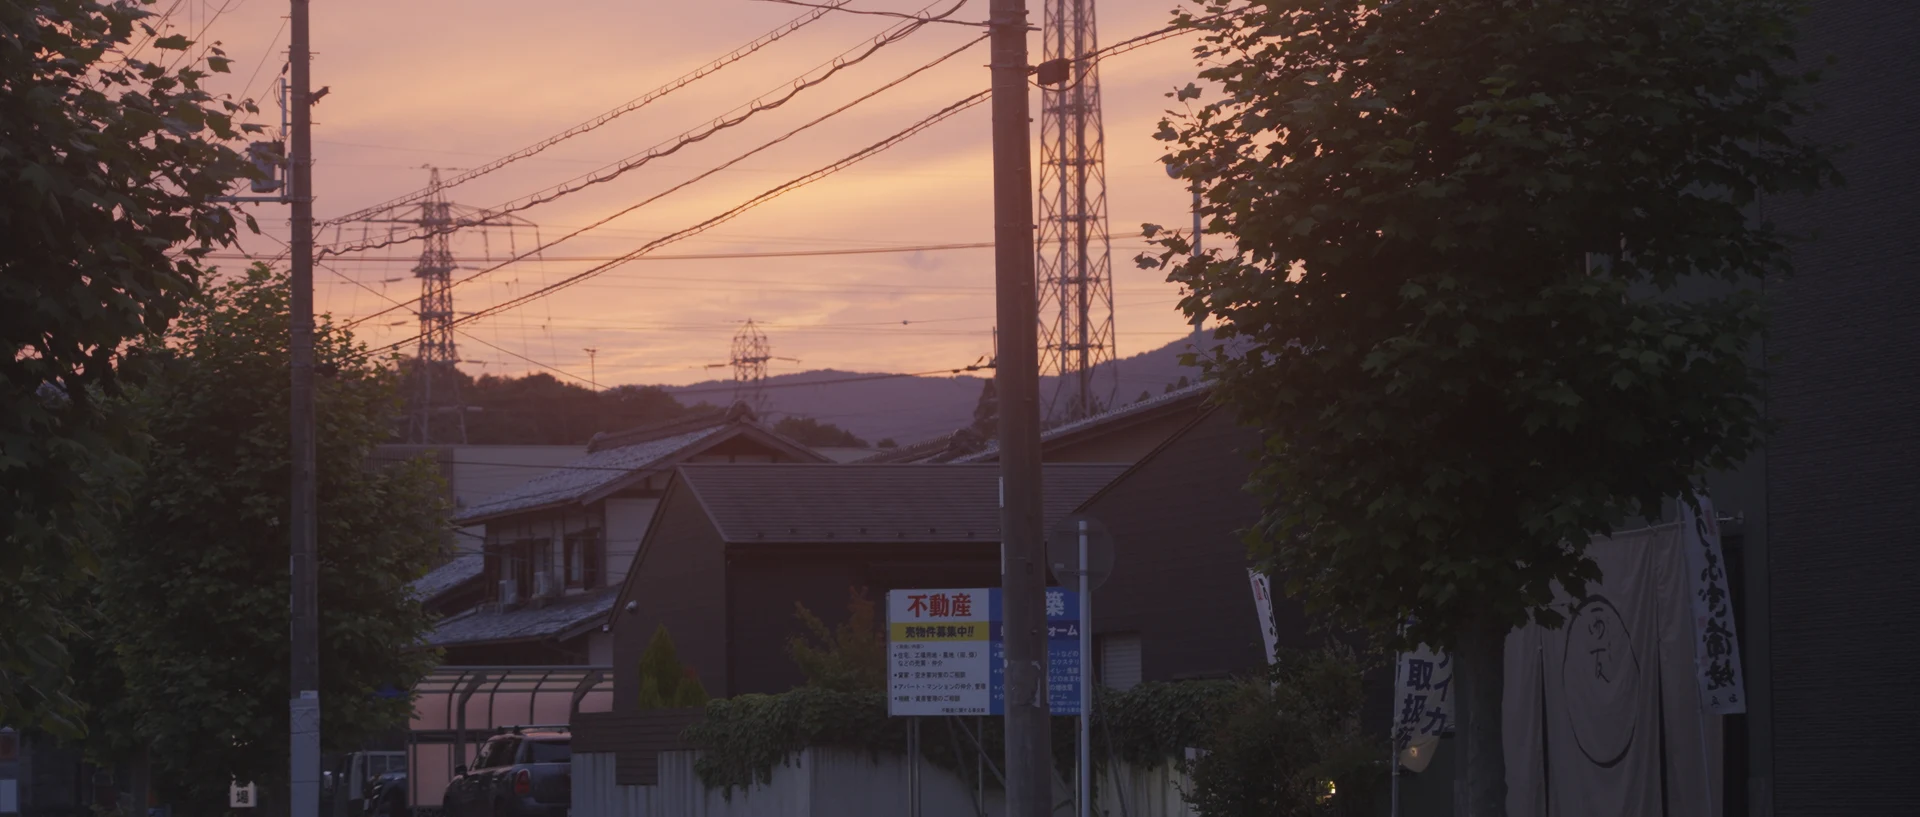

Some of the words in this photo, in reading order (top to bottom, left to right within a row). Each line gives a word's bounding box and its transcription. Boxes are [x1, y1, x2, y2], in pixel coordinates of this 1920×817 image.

[907, 592, 972, 618] 不動産
[1045, 591, 1065, 617] 築
